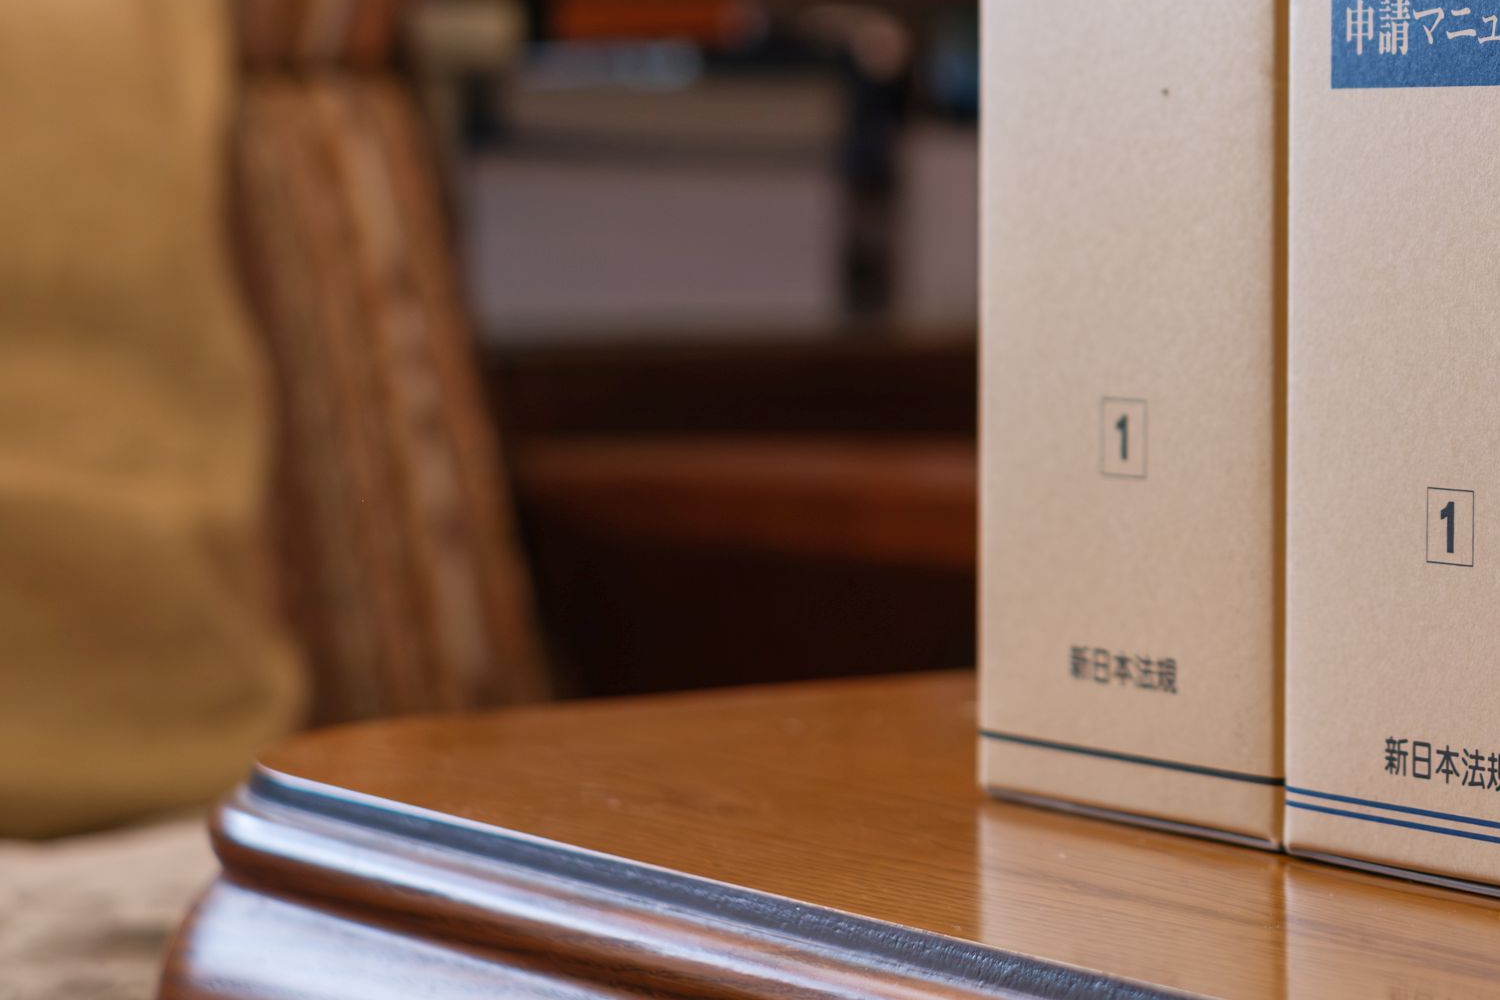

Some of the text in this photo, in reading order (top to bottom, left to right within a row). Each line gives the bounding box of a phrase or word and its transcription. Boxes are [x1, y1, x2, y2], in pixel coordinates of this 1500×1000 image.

[1115, 414, 1128, 461] 1
[1440, 501, 1455, 553] 1
[1070, 645, 1178, 695] 新日本法規
